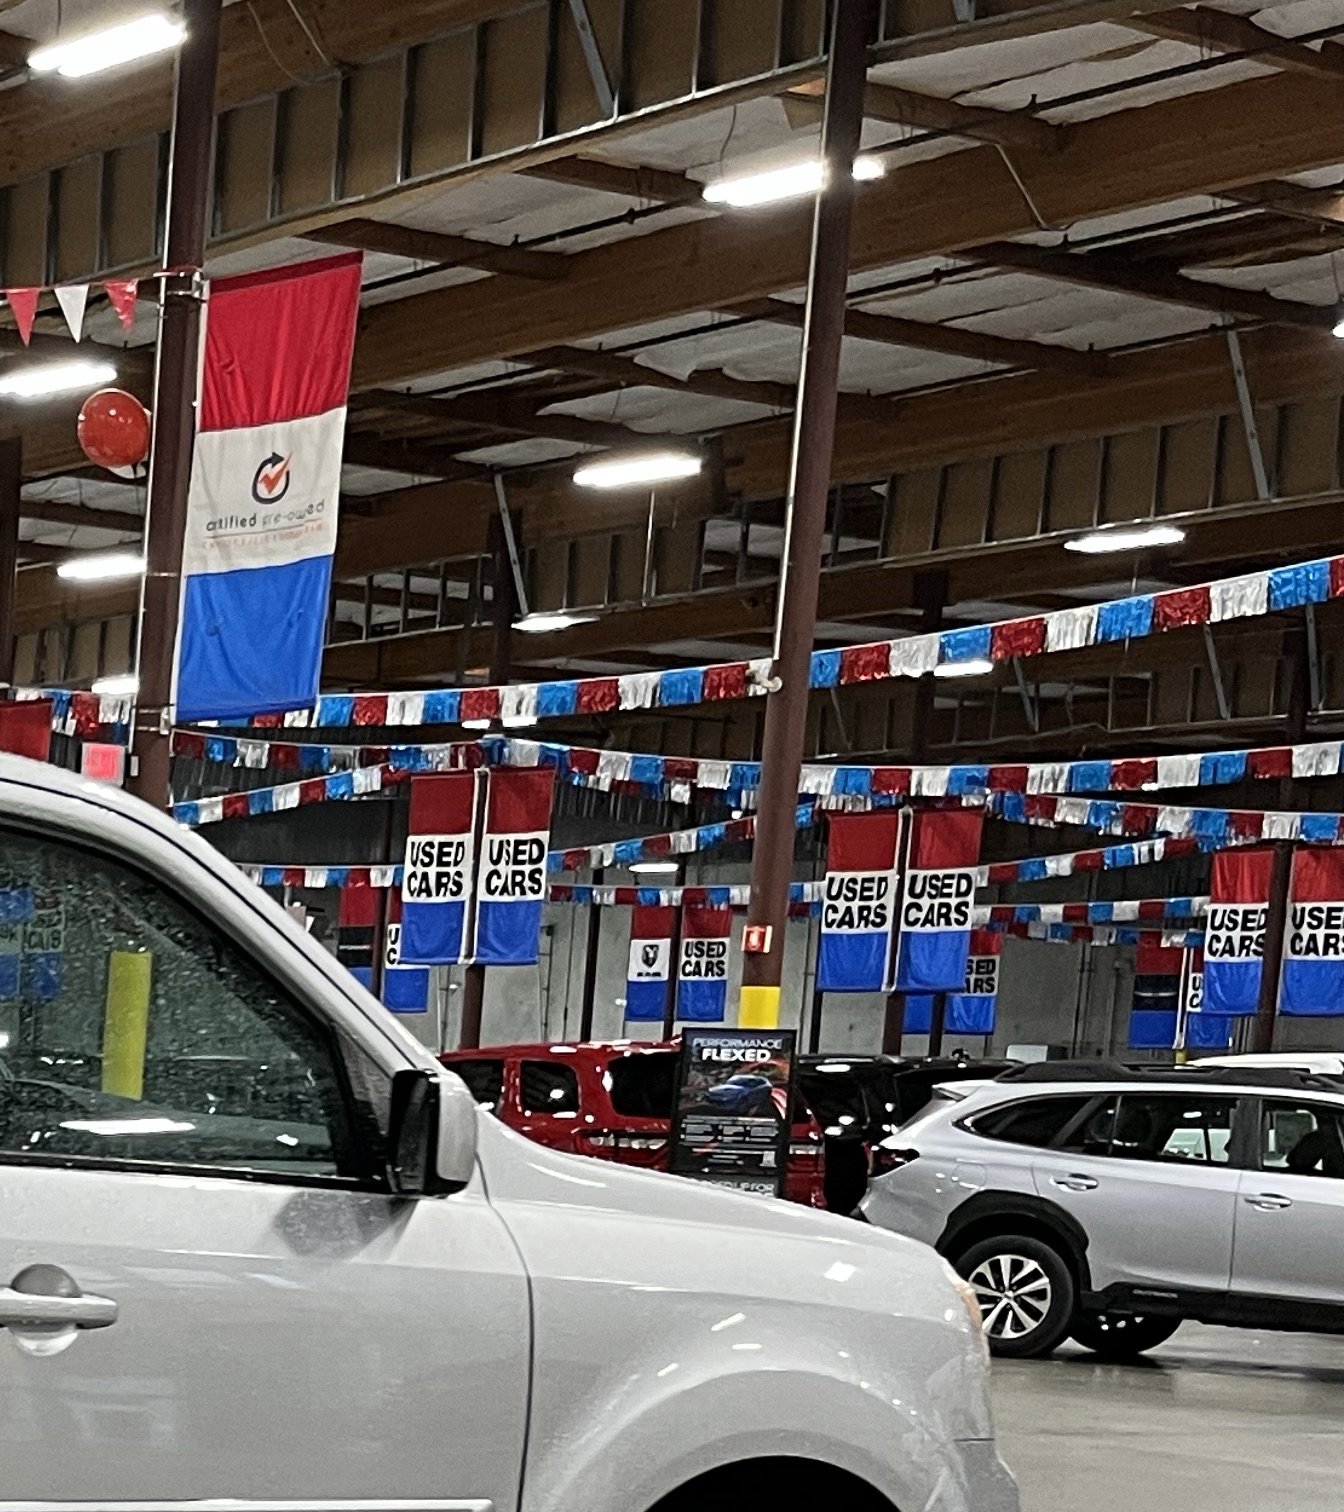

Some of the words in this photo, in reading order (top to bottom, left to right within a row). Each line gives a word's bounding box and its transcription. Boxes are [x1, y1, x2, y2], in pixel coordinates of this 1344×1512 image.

[410, 841, 465, 868] USED
[489, 838, 545, 866] USED
[407, 870, 464, 898] CARS
[485, 868, 544, 897] CARS
[825, 876, 889, 902] USED
[908, 873, 973, 899] USED
[824, 903, 887, 929] CARS
[904, 901, 970, 927] CARS
[1292, 905, 1344, 930] USE
[684, 941, 727, 958] USED
[1208, 933, 1265, 957] CARS
[1290, 932, 1344, 956] CAR
[681, 960, 726, 977] CARS
[965, 959, 996, 975] SED
[965, 977, 995, 993] RS
[693, 1037, 783, 1050] PERFORMANCE
[702, 1048, 771, 1062] FLEXED
